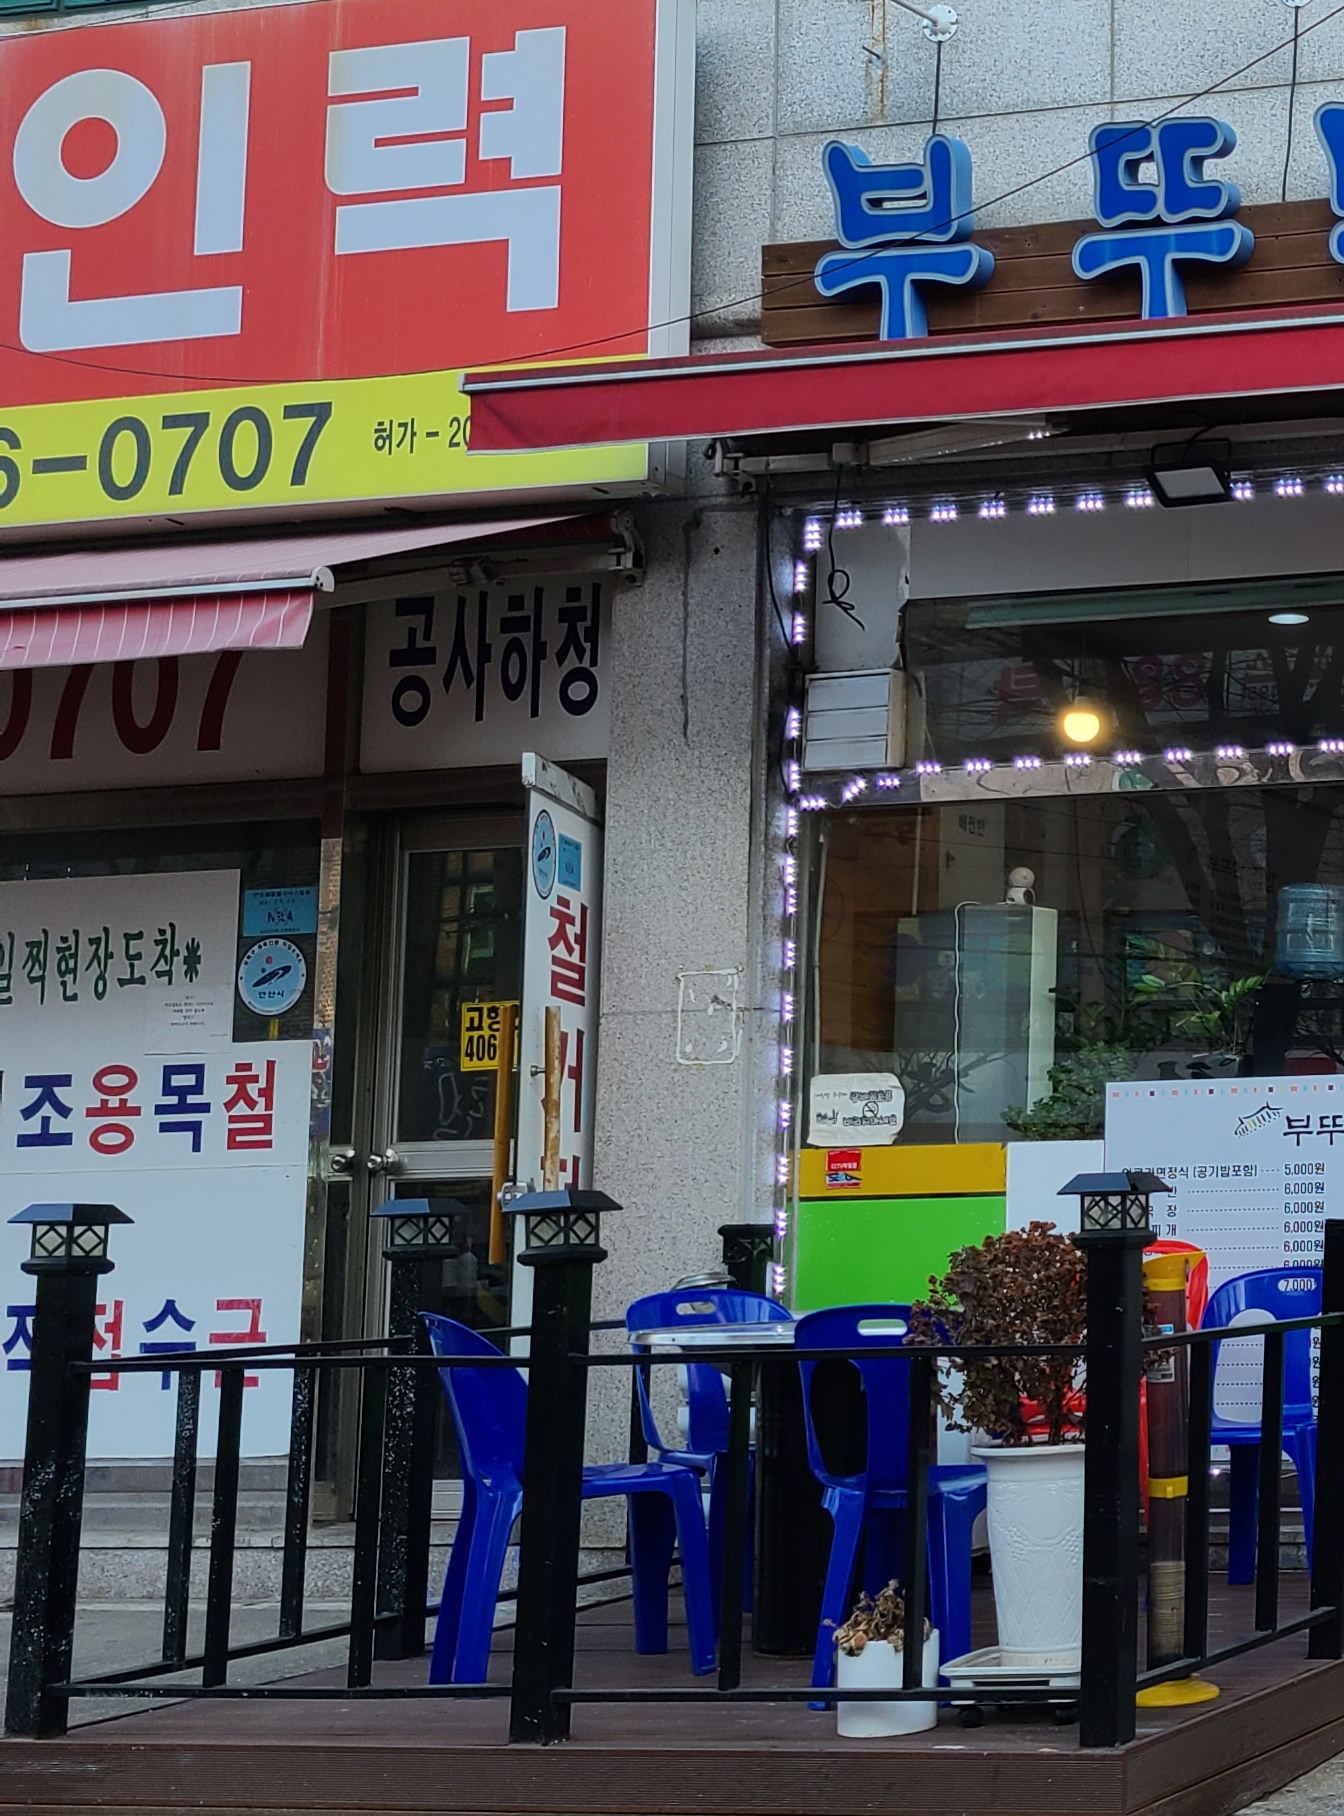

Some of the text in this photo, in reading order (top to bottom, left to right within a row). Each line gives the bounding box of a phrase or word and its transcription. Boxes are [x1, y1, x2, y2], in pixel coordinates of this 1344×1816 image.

[13, 26, 567, 352] 인력
[374, 418, 418, 457] 허가
[388, 581, 600, 727] 공사하청
[541, 894, 589, 1192] 철거
[1193, 1163, 1258, 1179] (공기밥포함)
[1284, 1162, 1325, 1176] 5,000원
[1284, 1181, 1325, 1195] 6,000원
[1284, 1200, 1325, 1214] 6,000원
[1284, 1220, 1325, 1233] 6,000원
[1283, 1239, 1324, 1253] 6,000원
